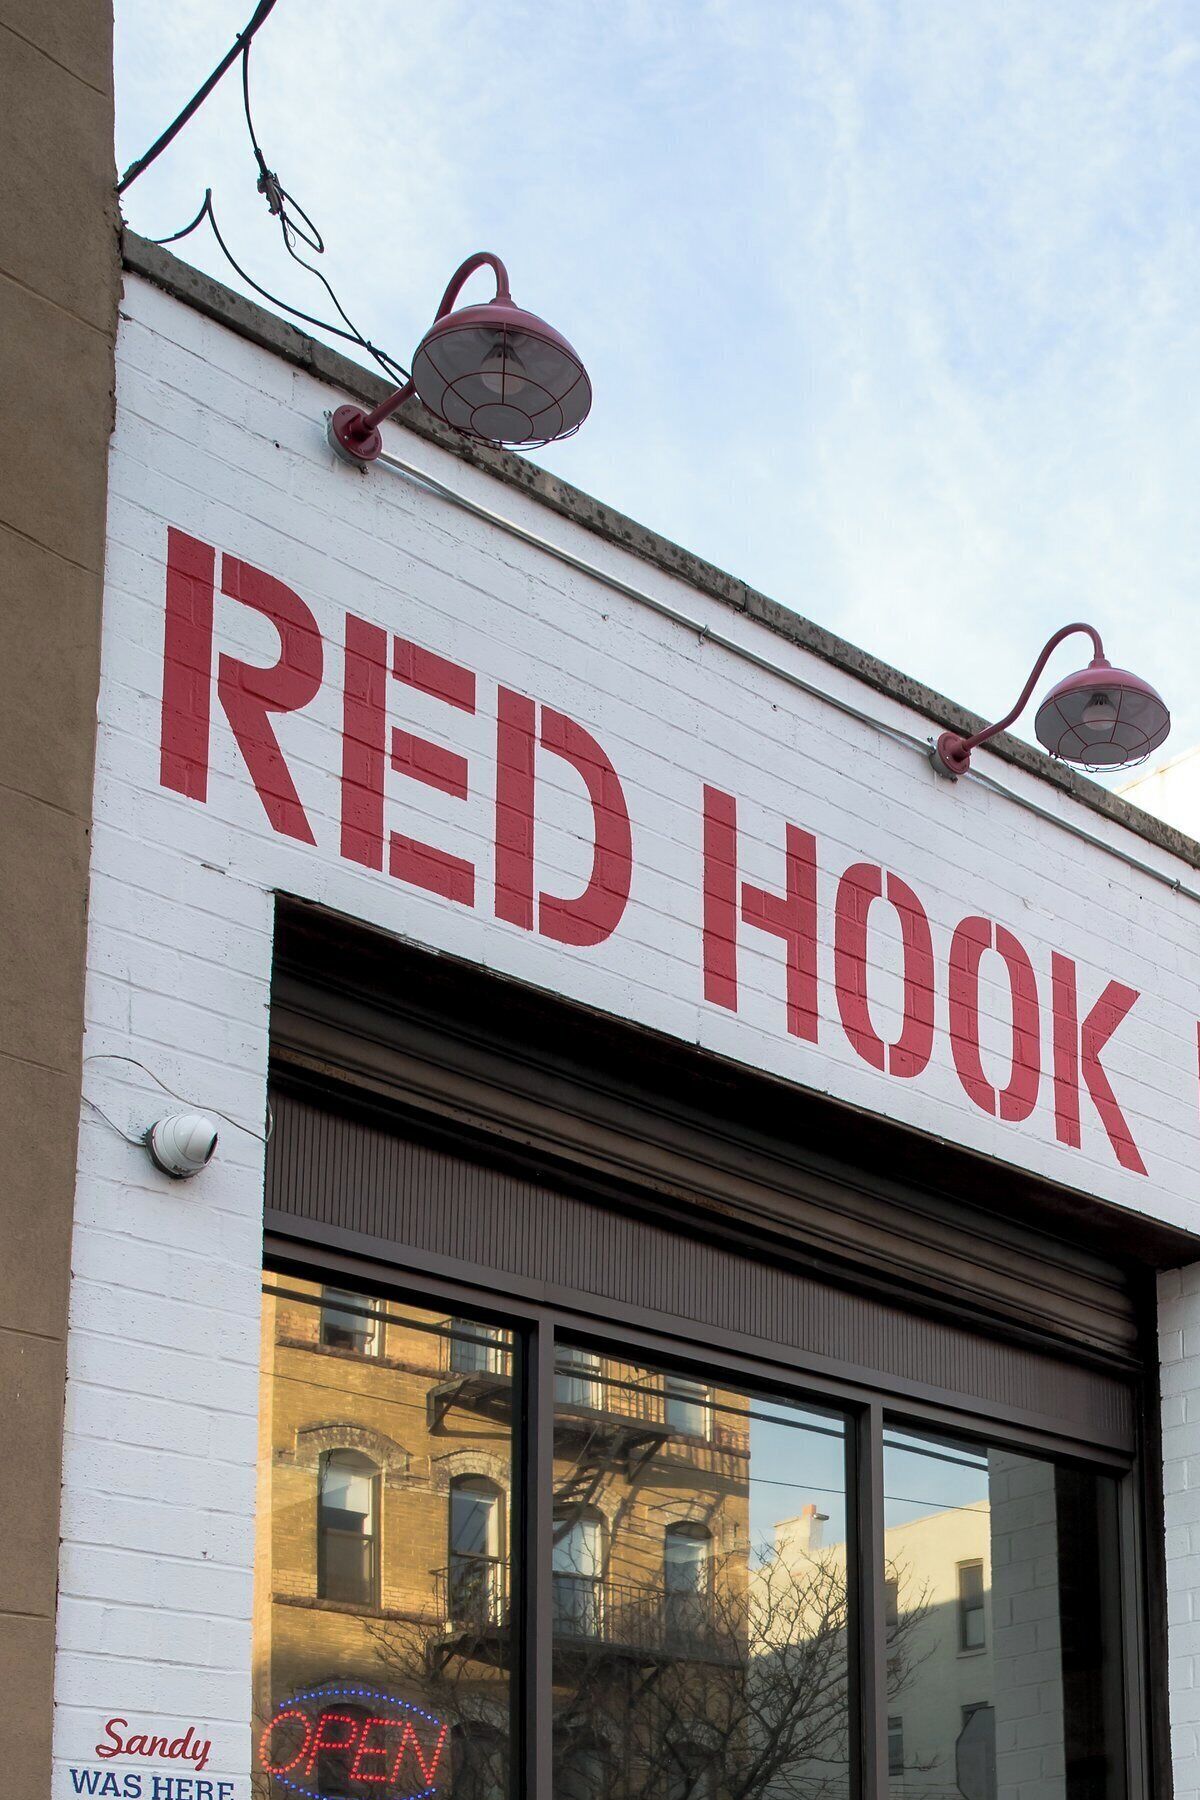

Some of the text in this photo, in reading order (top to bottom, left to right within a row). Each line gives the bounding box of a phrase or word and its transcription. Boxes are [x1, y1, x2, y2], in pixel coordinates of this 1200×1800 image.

[160, 525, 633, 947] RED
[703, 783, 1149, 1177] HOOK
[95, 1718, 213, 1771] Sandy
[259, 1710, 448, 1786] OPEN
[69, 1769, 142, 1799] WAS
